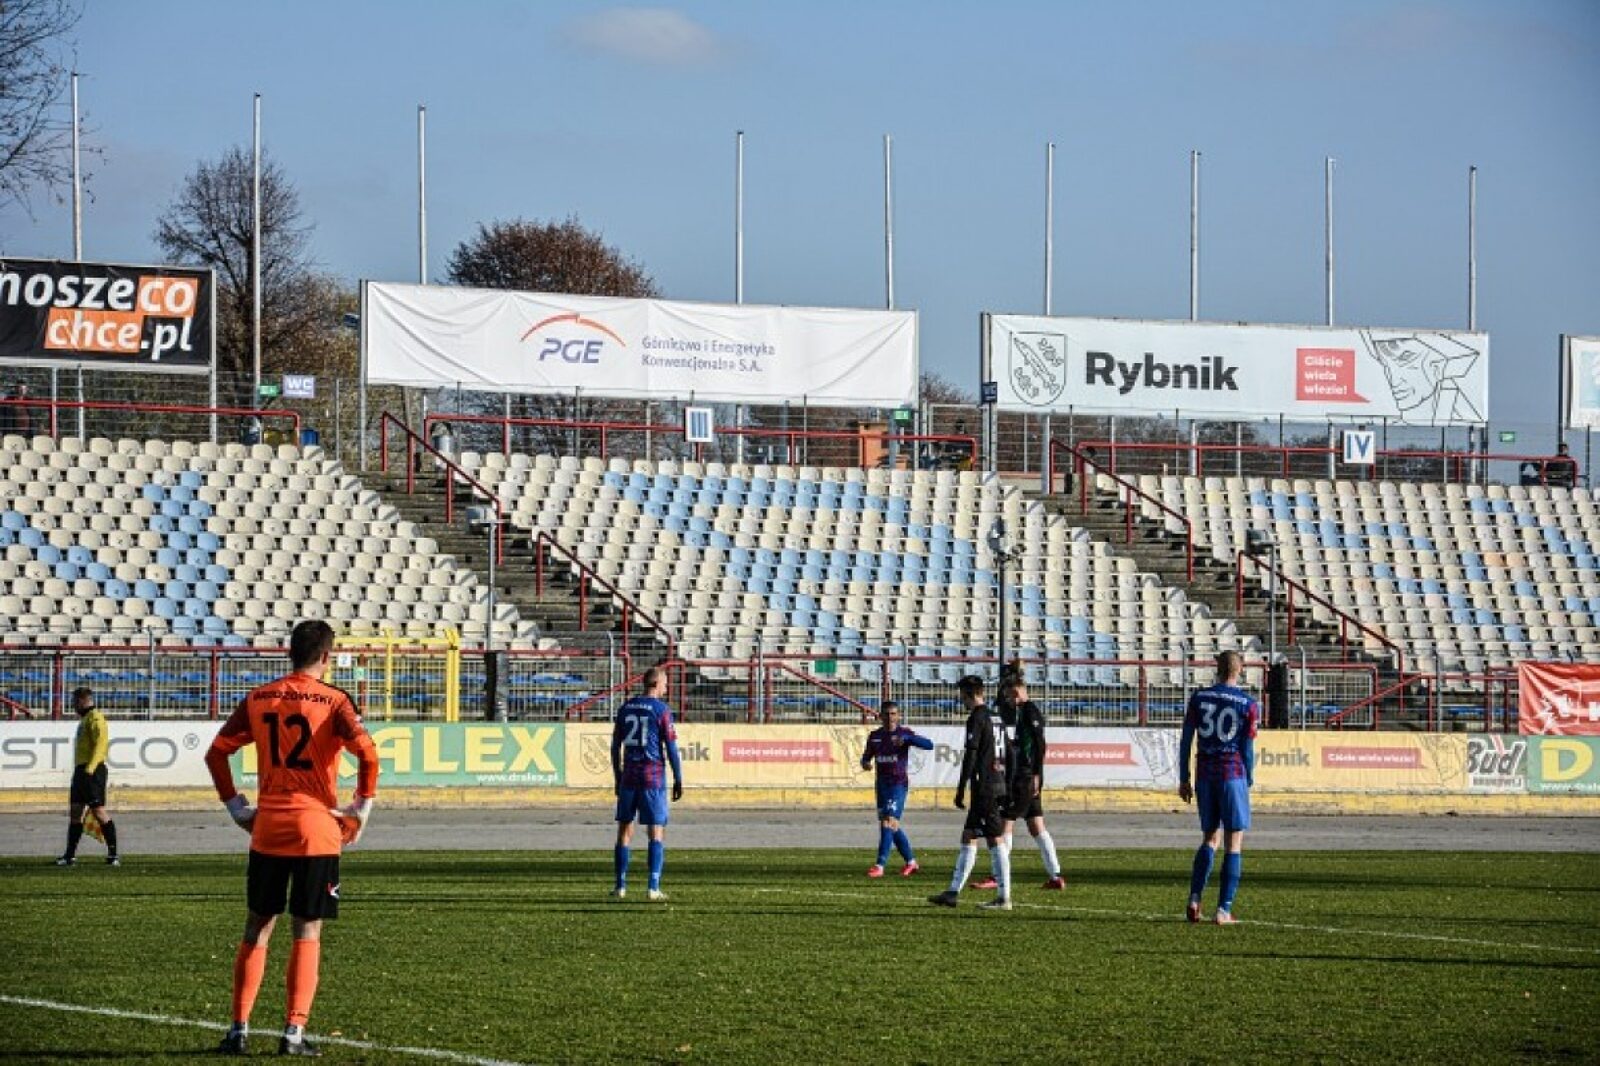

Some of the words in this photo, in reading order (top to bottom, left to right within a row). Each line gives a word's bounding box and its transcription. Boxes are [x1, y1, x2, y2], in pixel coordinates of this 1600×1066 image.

[48, 311, 192, 360] chce.pl
[539, 338, 603, 363] PGE
[641, 336, 700, 351] Górnictwo
[703, 339, 708, 352] i
[712, 340, 775, 357] Energetyka
[739, 358, 763, 372] S.A.
[1086, 351, 1239, 395] Rybnik
[288, 378, 312, 391] WC
[691, 411, 708, 439] III
[1346, 433, 1371, 460] IV
[624, 713, 649, 746] 21
[1199, 702, 1238, 742] 30
[243, 726, 557, 773] ALEX
[262, 712, 313, 769] 12
[680, 743, 710, 762] nik
[1467, 738, 1526, 775] Bud
